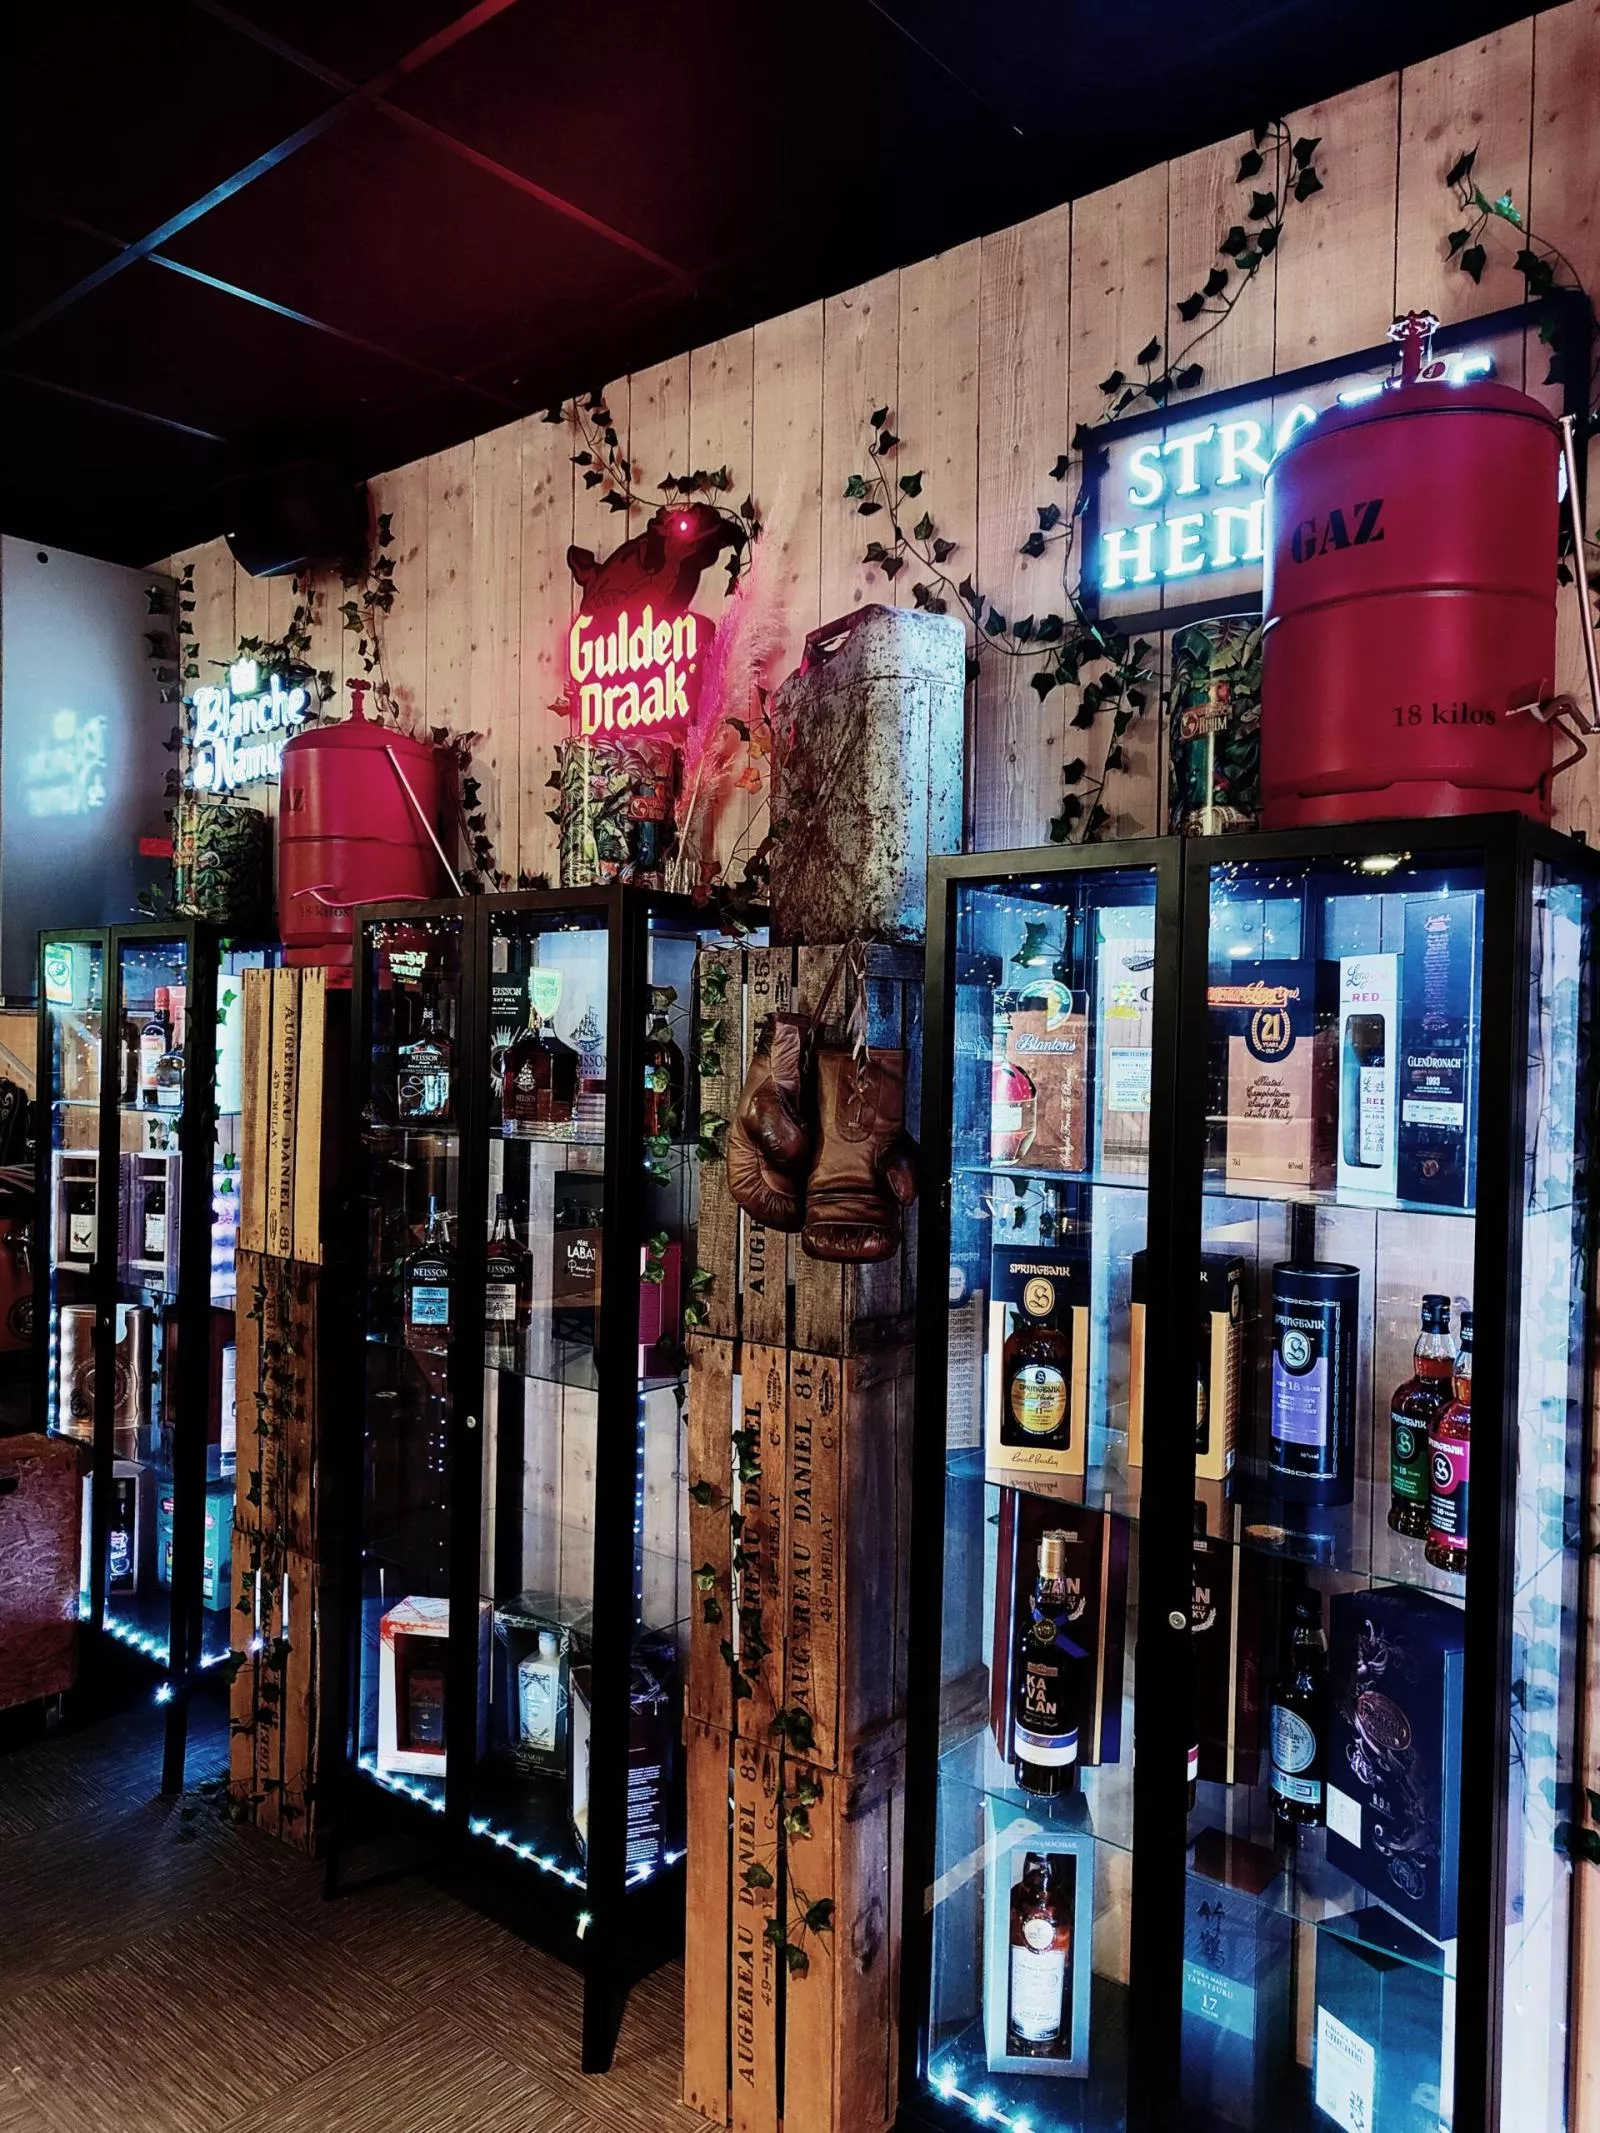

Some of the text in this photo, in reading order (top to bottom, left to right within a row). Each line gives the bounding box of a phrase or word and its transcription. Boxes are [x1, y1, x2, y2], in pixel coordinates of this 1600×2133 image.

[1291, 499, 1384, 564] GAZ
[569, 604, 697, 683] Gulden
[579, 661, 689, 735] Draak
[193, 673, 305, 747] Blanche
[1392, 702, 1497, 727] 18 kilos
[212, 735, 284, 793] Namu
[492, 987, 522, 996] EISSON
[1352, 992, 1380, 1002] RED
[1261, 1013, 1281, 1041] 21
[1015, 1033, 1076, 1052] Blanton's
[282, 1006, 296, 1121] AUGEREAU
[1254, 1075, 1284, 1087] Peated
[1248, 1097, 1290, 1111] Single Malt
[1268, 1109, 1293, 1125] Whisky
[279, 1136, 291, 1213] DANIEL
[413, 1267, 448, 1277] NEISSON
[487, 1265, 516, 1273] EISSON
[1009, 1263, 1071, 1277] SPRINGBANK
[1011, 1451, 1059, 1468] Local Barley
[793, 1417, 811, 1525] DANIEL
[1026, 1688, 1046, 1702] VA
[1026, 1697, 1057, 1714] LAN
[738, 1801, 756, 1910] DNIEL
[737, 1923, 755, 2089] AUGEREAU
[1201, 1994, 1218, 2010] 17
